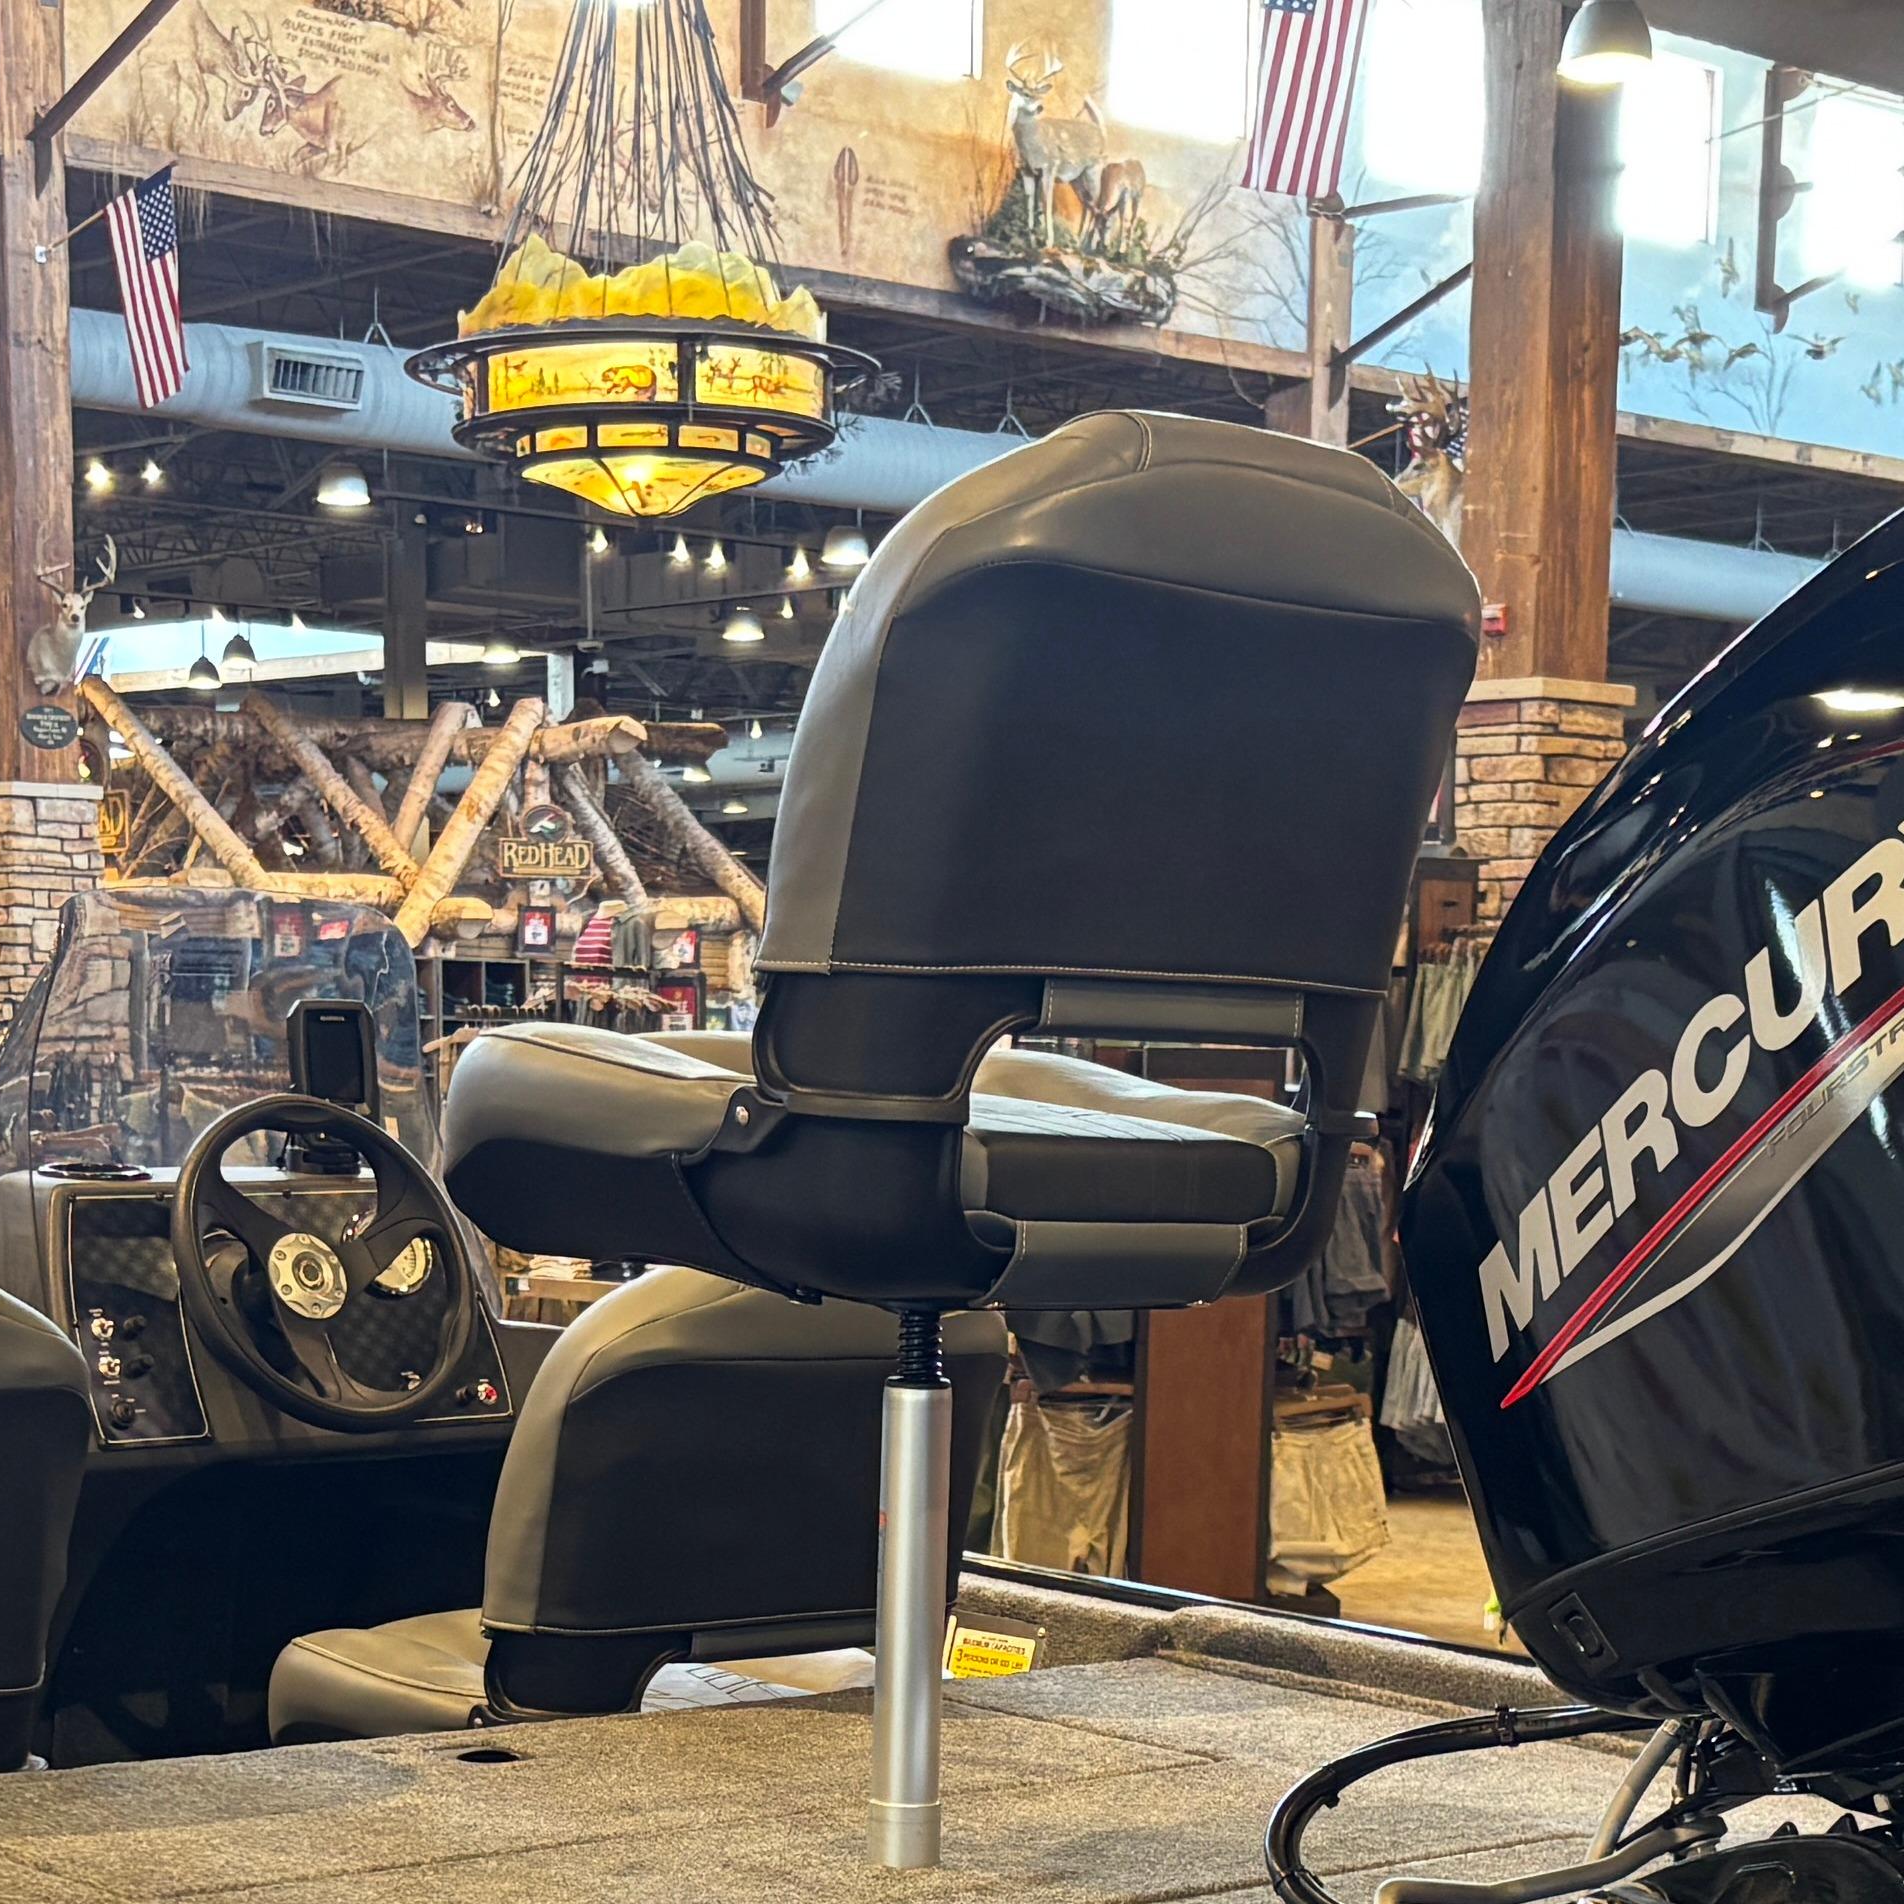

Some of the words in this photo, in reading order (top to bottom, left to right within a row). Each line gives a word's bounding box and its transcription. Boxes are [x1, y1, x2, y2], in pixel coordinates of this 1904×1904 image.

[296, 8, 356, 29] DOMINANT
[281, 18, 324, 37] BUCKS
[329, 29, 366, 45] FIGHT
[955, 1648, 964, 1663] 3
